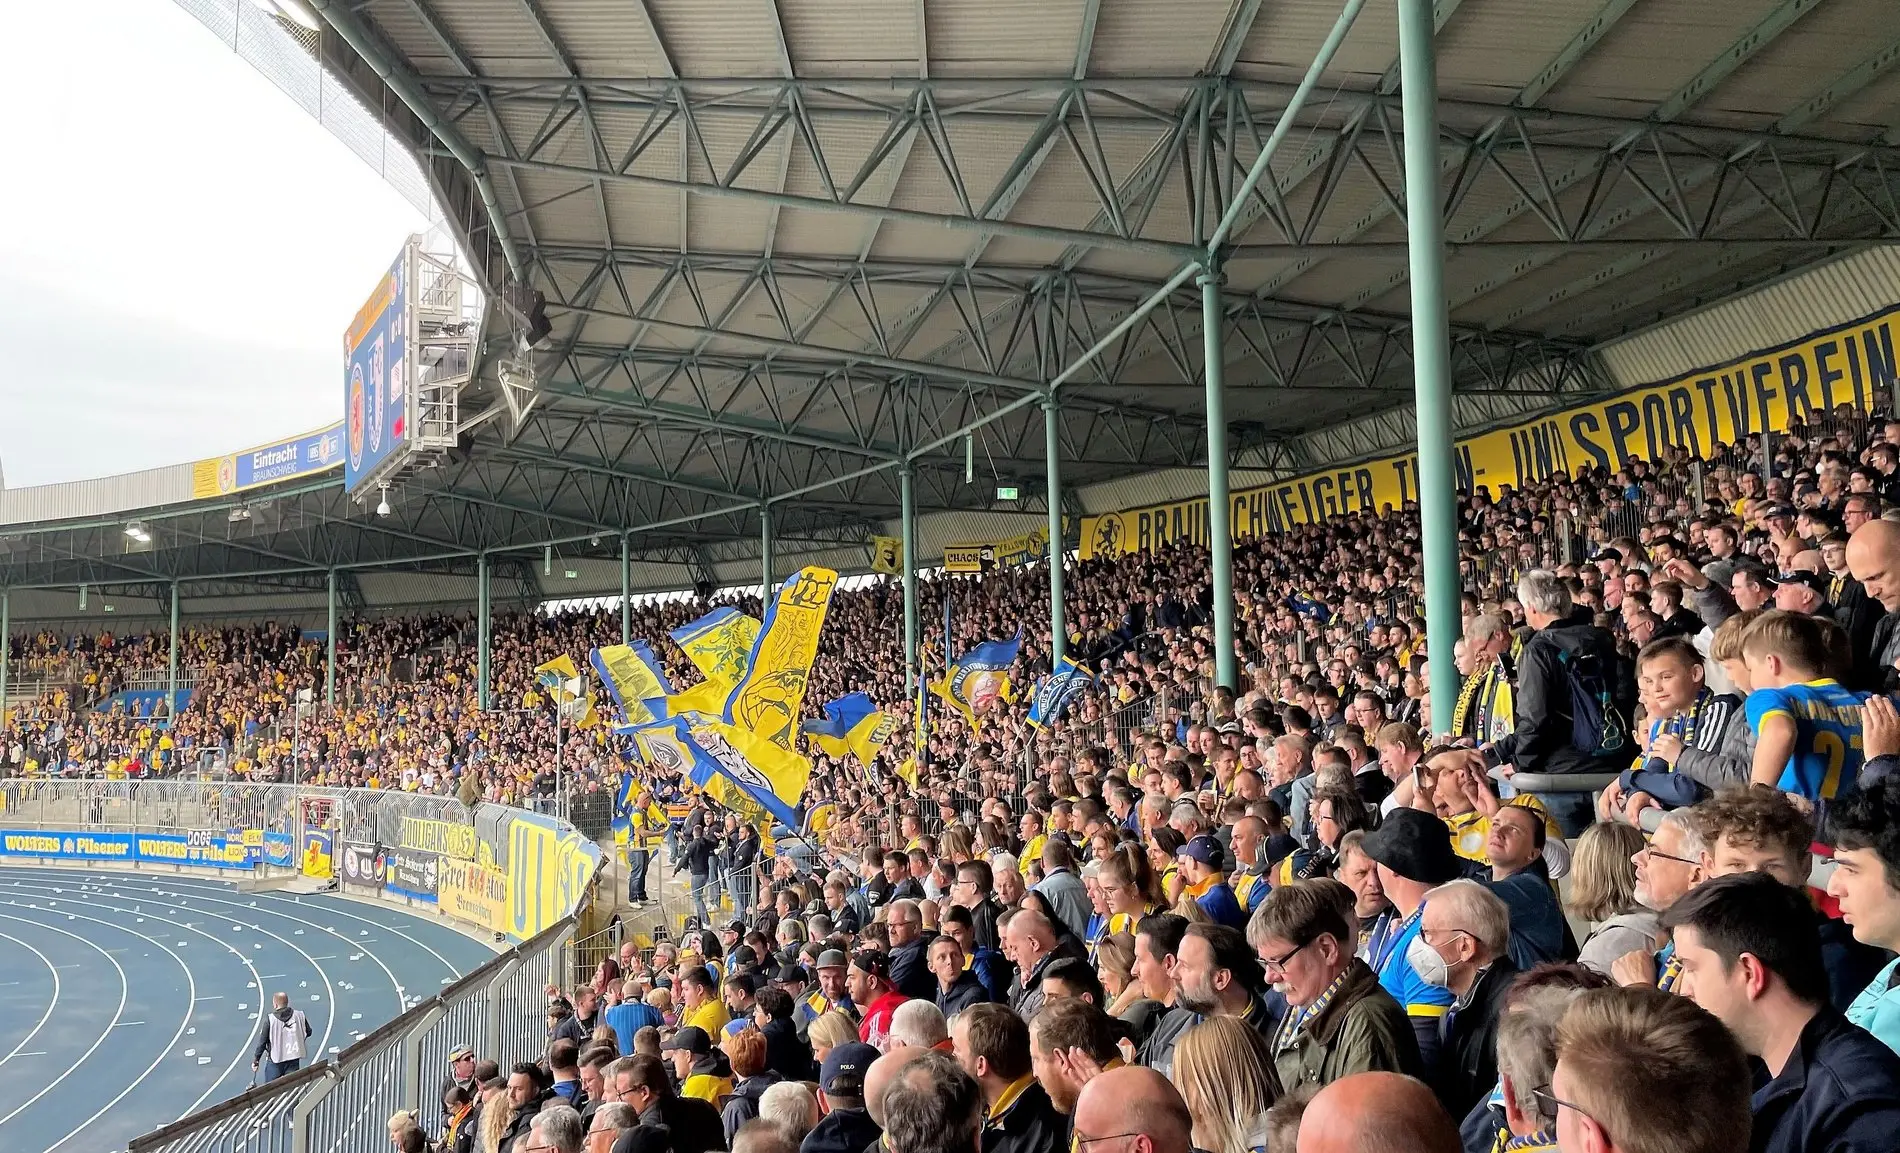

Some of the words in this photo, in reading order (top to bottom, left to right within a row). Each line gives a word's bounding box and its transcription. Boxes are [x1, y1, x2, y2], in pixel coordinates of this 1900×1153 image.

[1569, 323, 1897, 472] SPORTVEREIN
[253, 444, 298, 469] Eintracht
[252, 462, 297, 482] BRAUNSCHWEIG
[947, 553, 979, 562] CHAOS
[5, 836, 60, 852] WOLTERS
[76, 838, 129, 855] Pilsener
[187, 830, 211, 846] DOGS
[402, 818, 448, 854] HOOLIGANS
[138, 839, 188, 859] WOLTERS
[285, 1041, 300, 1055] 24
